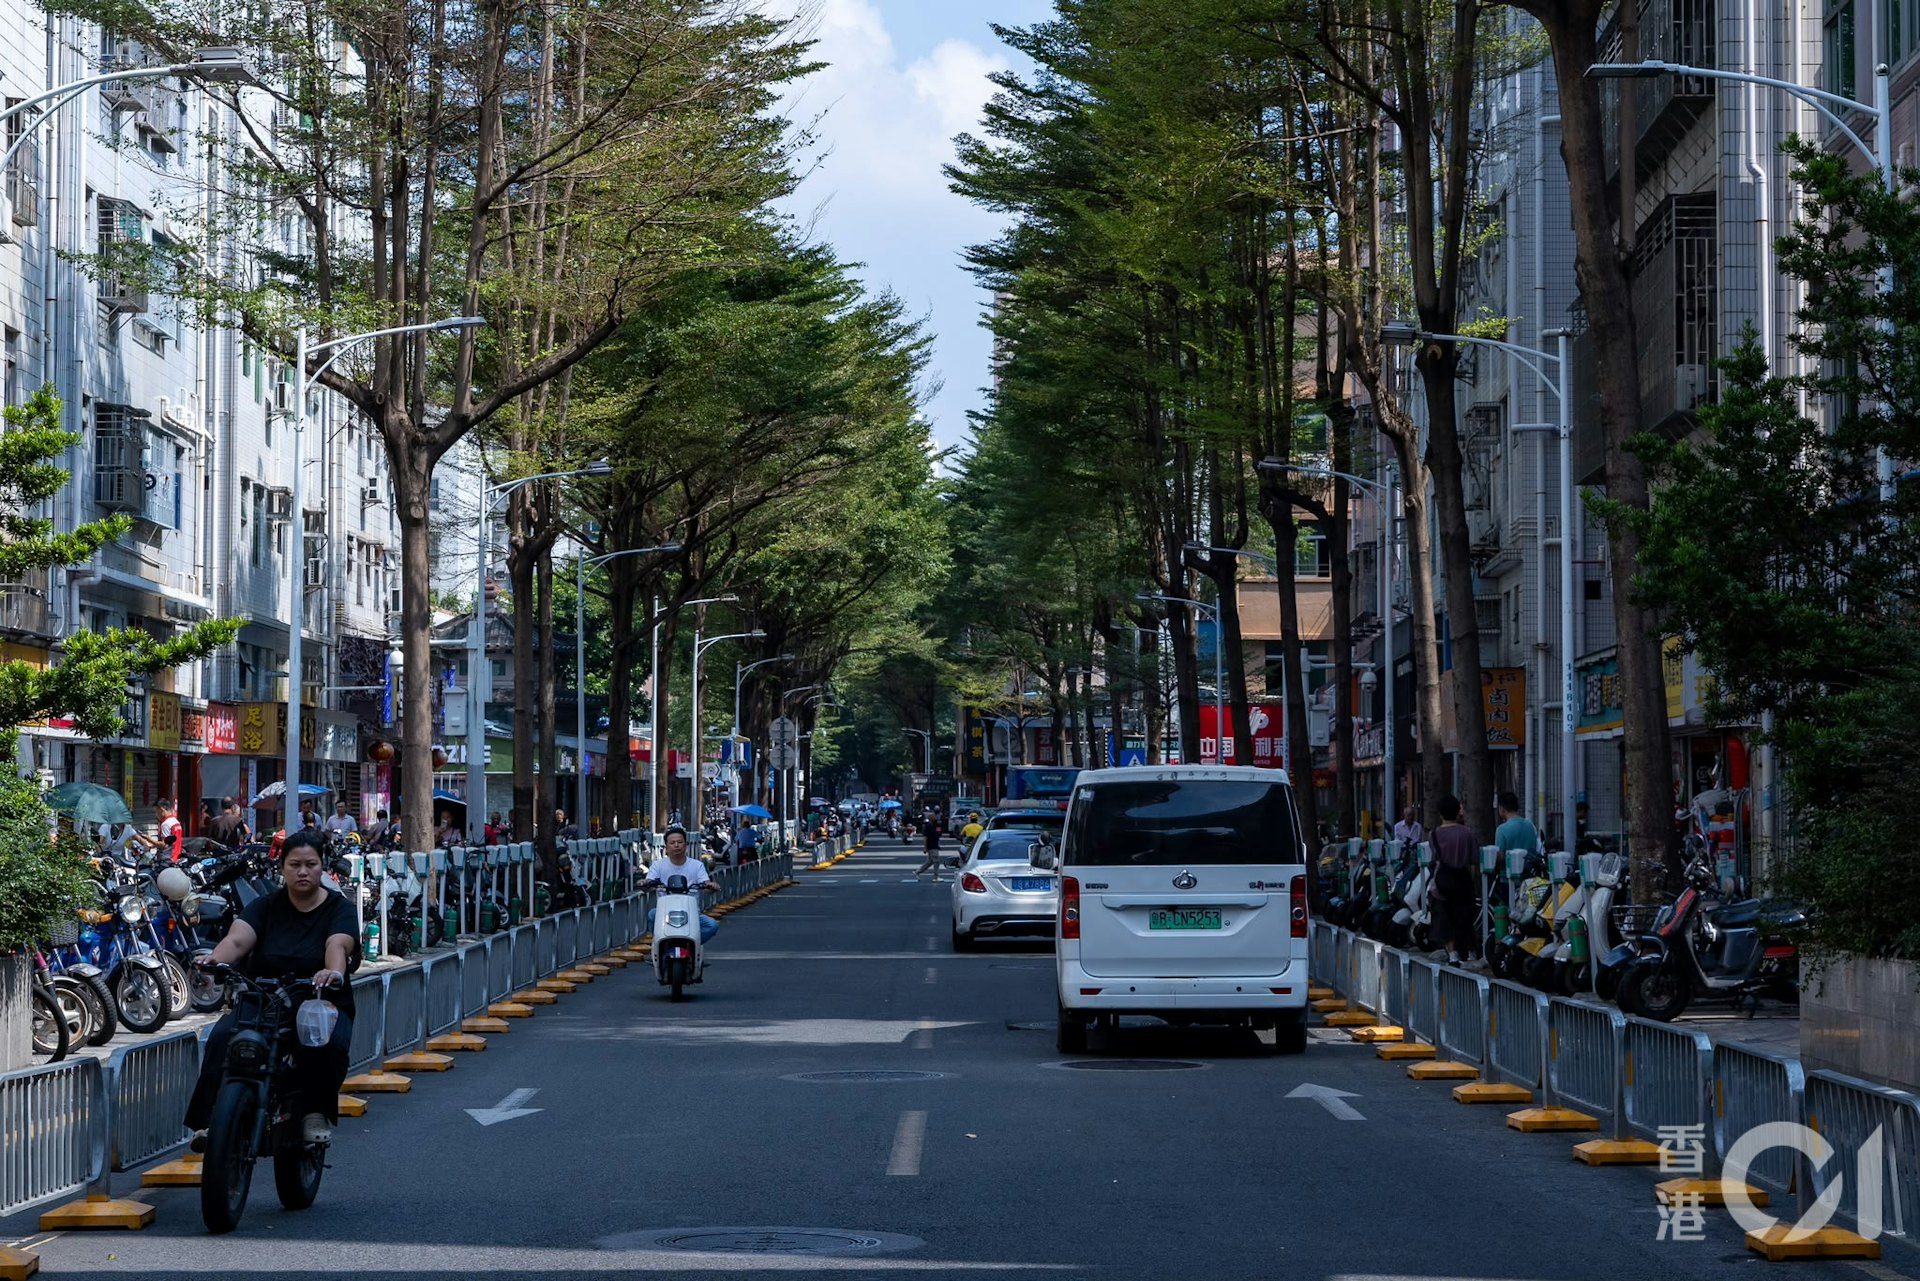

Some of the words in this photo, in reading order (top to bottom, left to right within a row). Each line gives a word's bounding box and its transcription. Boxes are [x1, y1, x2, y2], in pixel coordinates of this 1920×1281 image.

[151, 695, 178, 733] 黄金回收
[1487, 688, 1512, 741] 卤肉饭
[1566, 663, 1574, 732] 1118103
[243, 706, 264, 752] 足浴
[1200, 736, 1284, 757] 中国利彩
